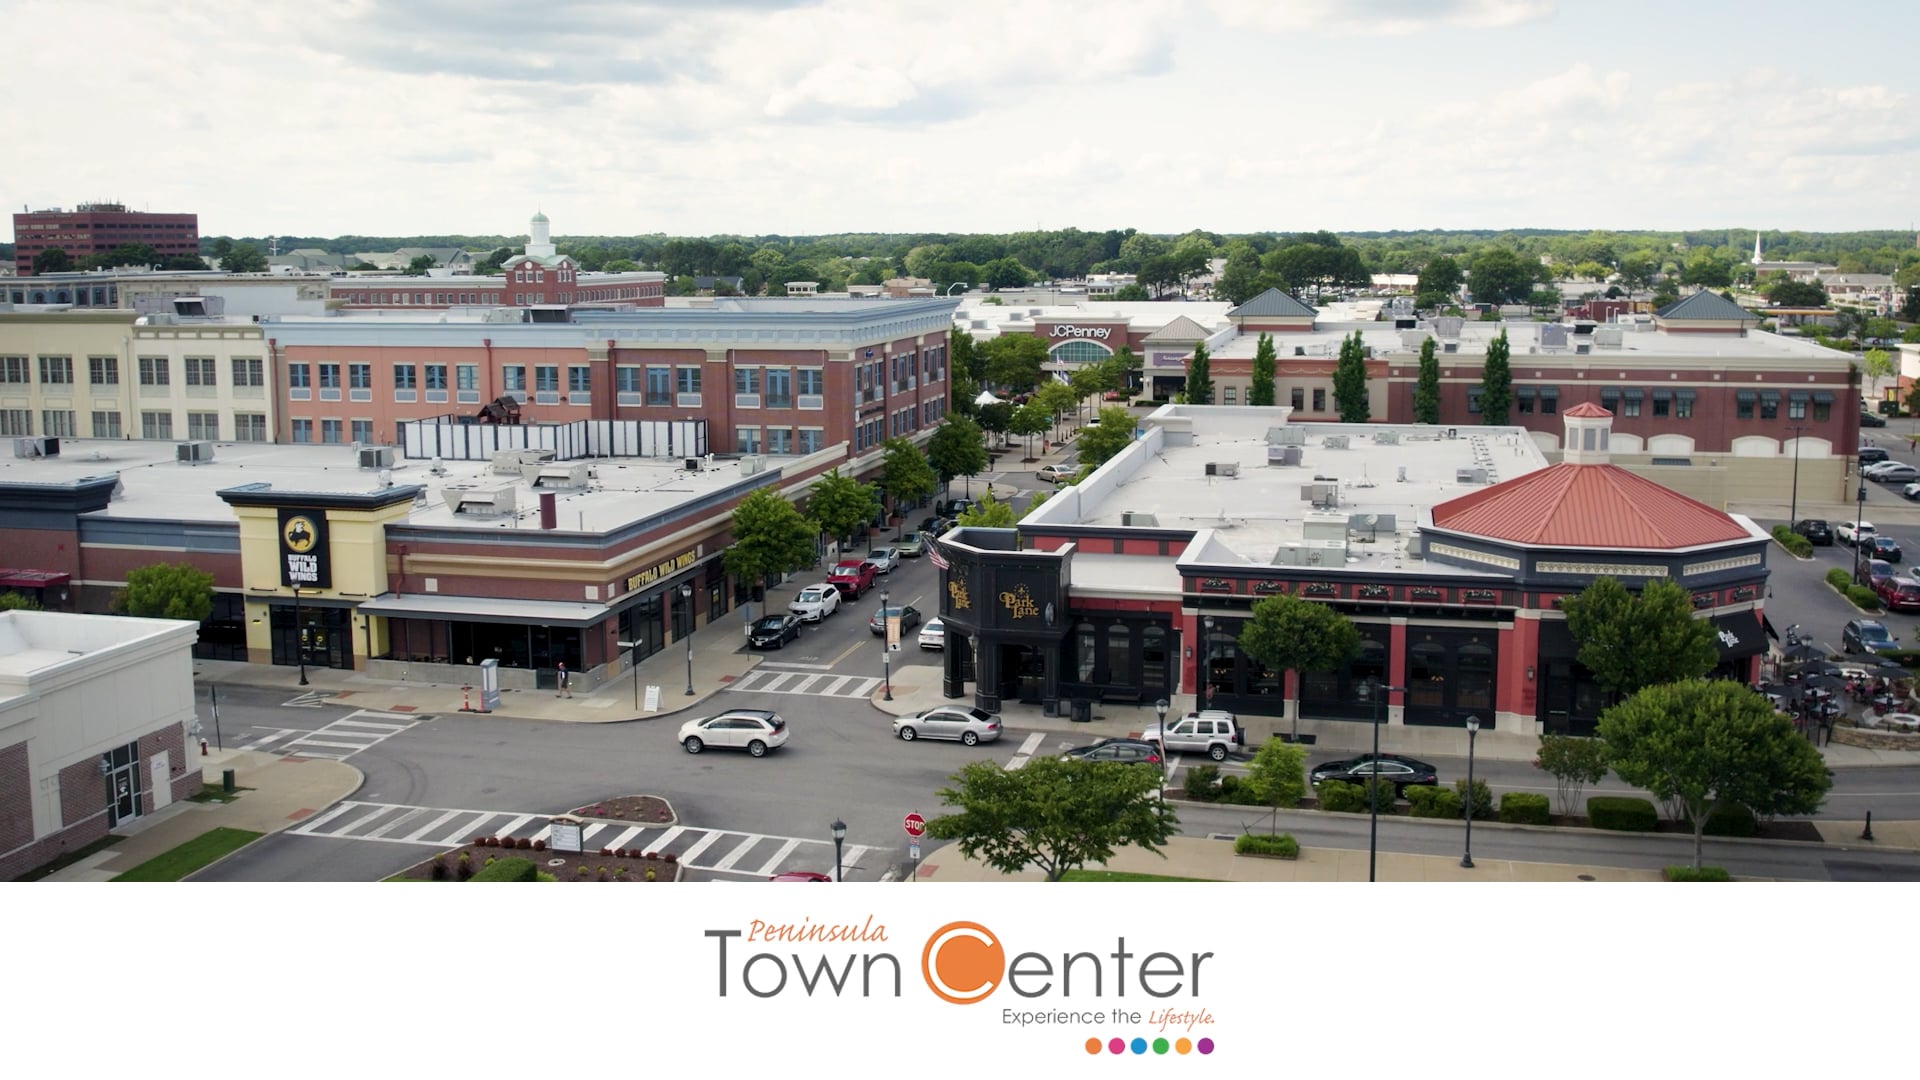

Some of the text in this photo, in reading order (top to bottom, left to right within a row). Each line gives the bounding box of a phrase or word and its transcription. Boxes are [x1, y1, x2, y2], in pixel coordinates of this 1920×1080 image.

[1049, 325, 1112, 339] JCPenney
[287, 554, 318, 562] BUFFALO
[288, 561, 318, 572] WILD
[628, 550, 695, 592] BUFFALO WILD WINGS
[288, 571, 318, 582] WINGS
[999, 592, 1034, 608] Park
[1012, 606, 1039, 619] Lane
